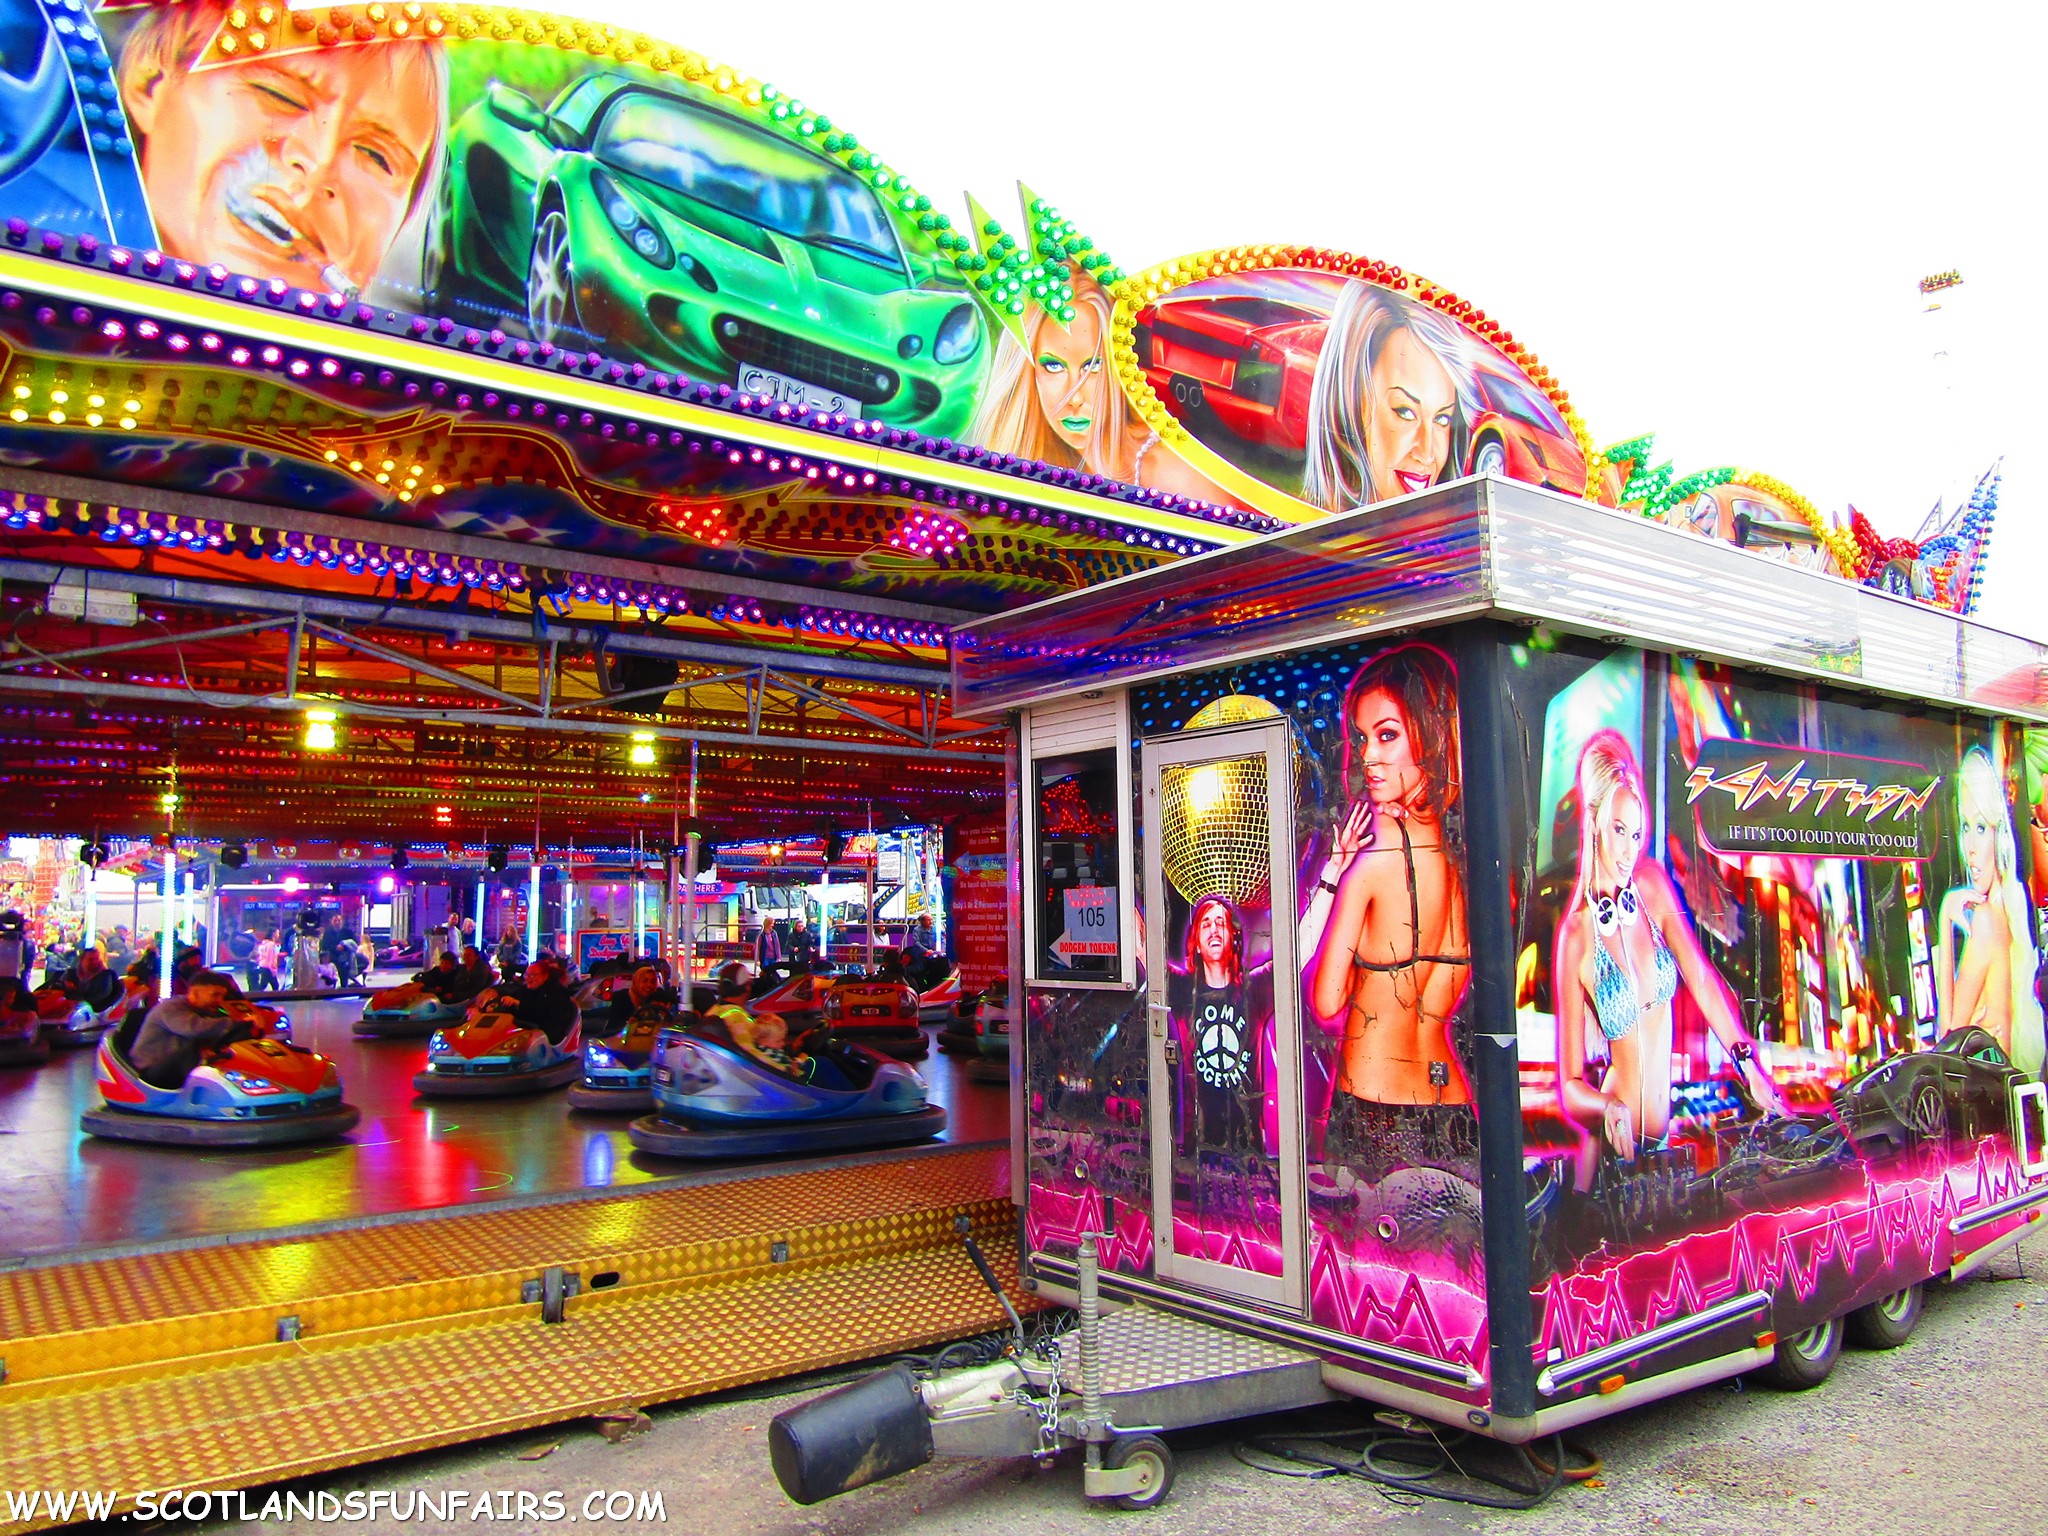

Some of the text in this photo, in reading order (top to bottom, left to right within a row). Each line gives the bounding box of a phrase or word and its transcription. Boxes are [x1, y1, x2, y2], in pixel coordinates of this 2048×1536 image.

[1728, 825, 1740, 839] IF
[1743, 825, 1766, 841] IT'S
[1768, 827, 1797, 842] TOO
[1800, 829, 1833, 844] LOUD
[1834, 831, 1868, 846] YOUR
[1868, 833, 1893, 847] TOO
[988, 923, 994, 932] by
[1078, 907, 1105, 927] 105
[1060, 942, 1117, 954] DODGEM TOKENS
[1195, 1004, 1246, 1033] COME
[1193, 1049, 1251, 1089] TOGETHER
